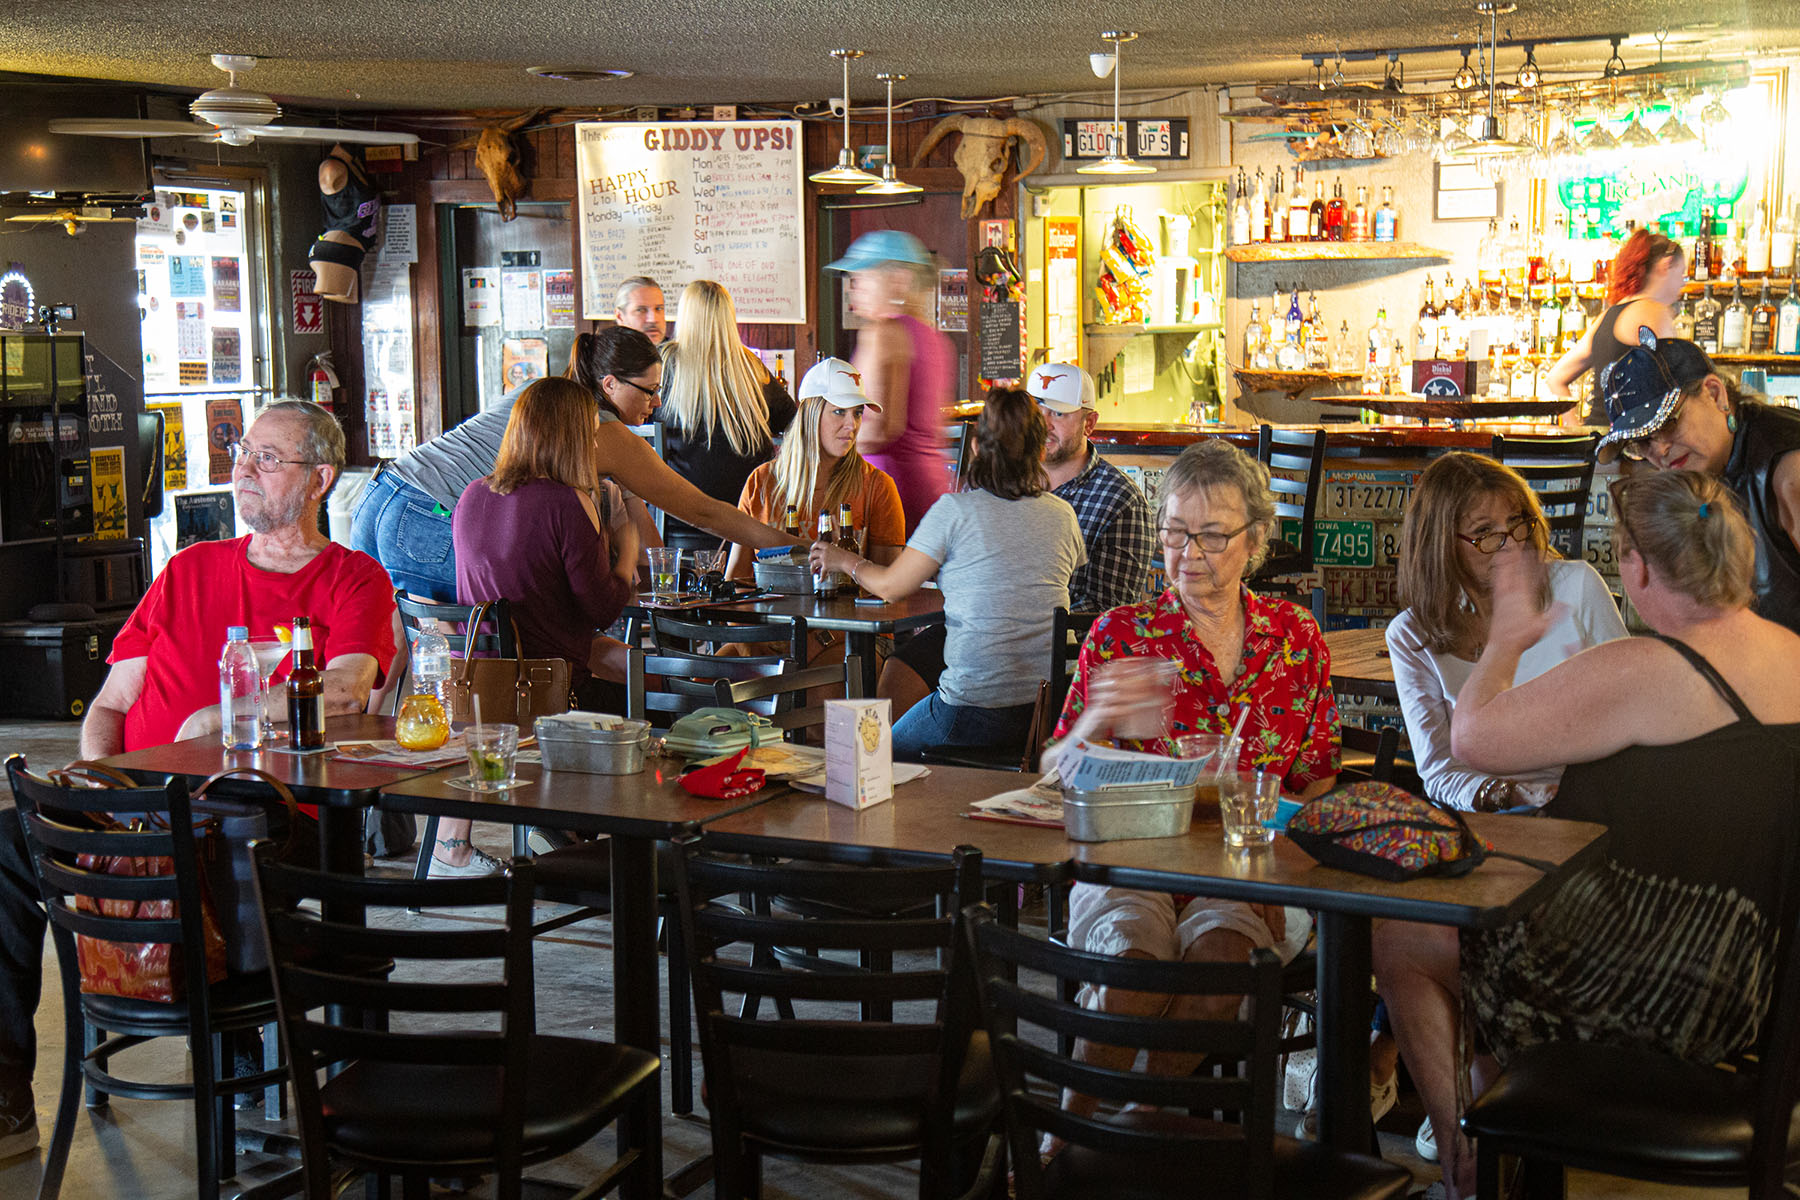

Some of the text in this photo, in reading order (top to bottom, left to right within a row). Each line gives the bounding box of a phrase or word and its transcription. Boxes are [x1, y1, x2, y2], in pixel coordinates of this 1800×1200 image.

[582, 130, 601, 141] This
[644, 127, 793, 151] GIDDY UPS!
[692, 157, 713, 169] Mon
[590, 168, 648, 195] HAPPY
[693, 171, 711, 183] Tue
[624, 180, 680, 204] HOUR
[693, 186, 715, 197] Wed
[694, 200, 713, 212] Thu
[587, 209, 622, 223] Monday
[632, 203, 662, 215] Friday
[695, 214, 709, 226] Fri
[694, 229, 708, 241] Sat
[694, 243, 712, 255] Sun
[1332, 472, 1376, 481] MONTANA
[1317, 532, 1369, 557] 7495
